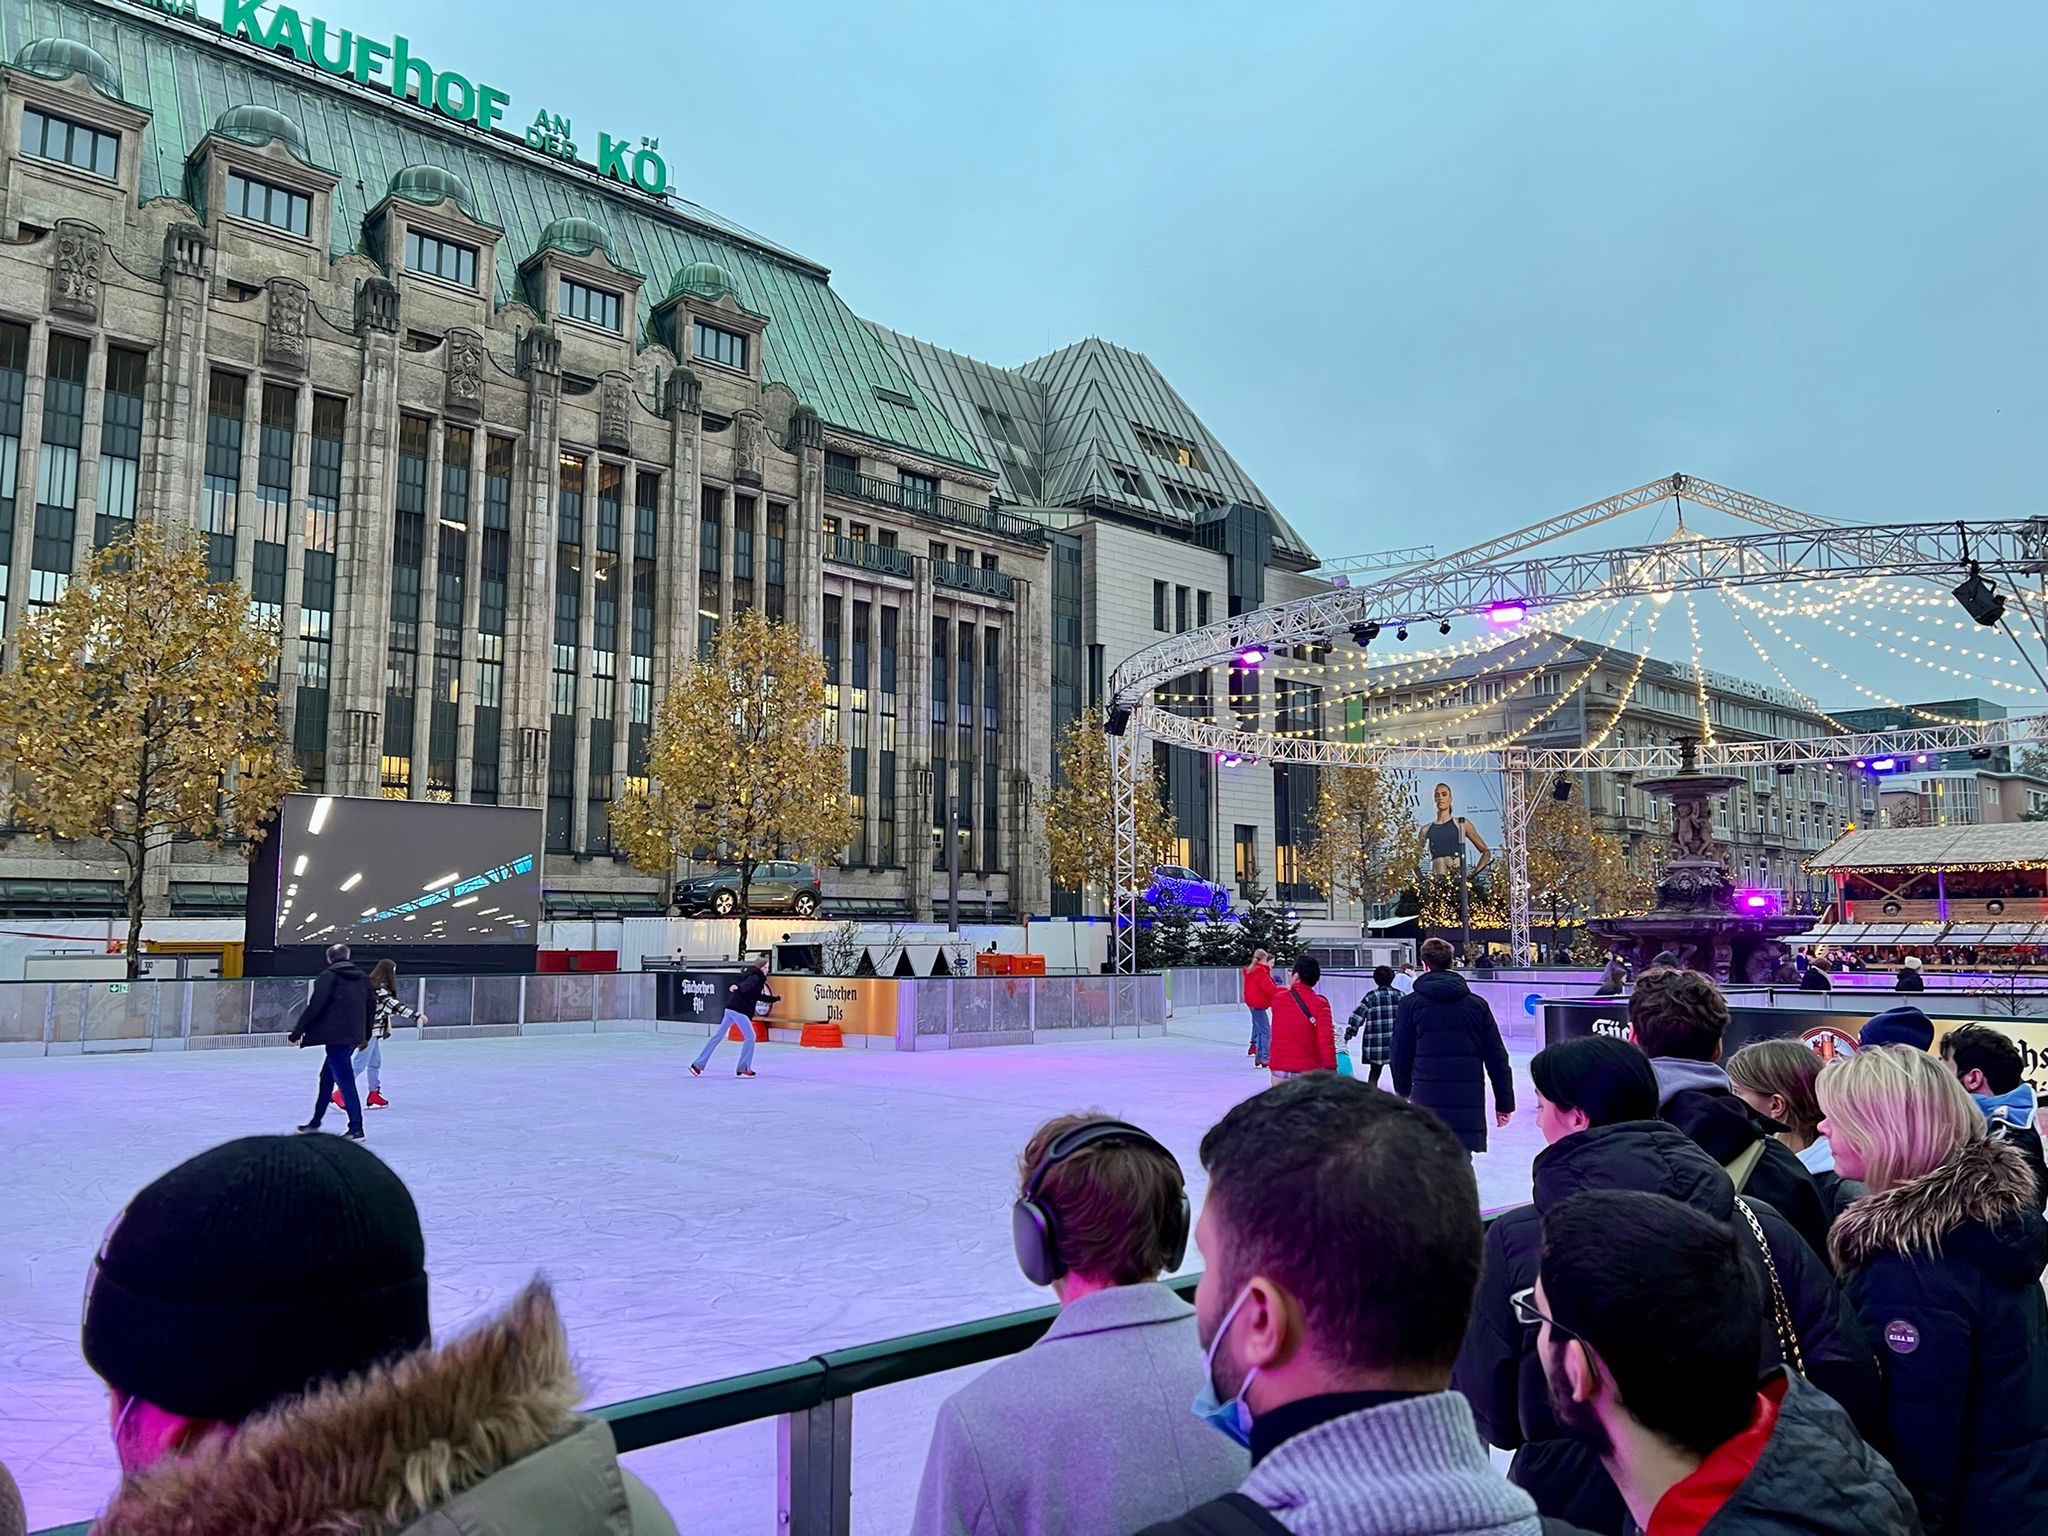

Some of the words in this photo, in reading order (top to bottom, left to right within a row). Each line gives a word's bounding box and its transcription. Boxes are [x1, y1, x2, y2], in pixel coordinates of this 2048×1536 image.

[533, 108, 571, 140] AN
[525, 126, 578, 163] DER
[597, 131, 667, 194] KÖ
[827, 1004, 844, 1023] Pils
